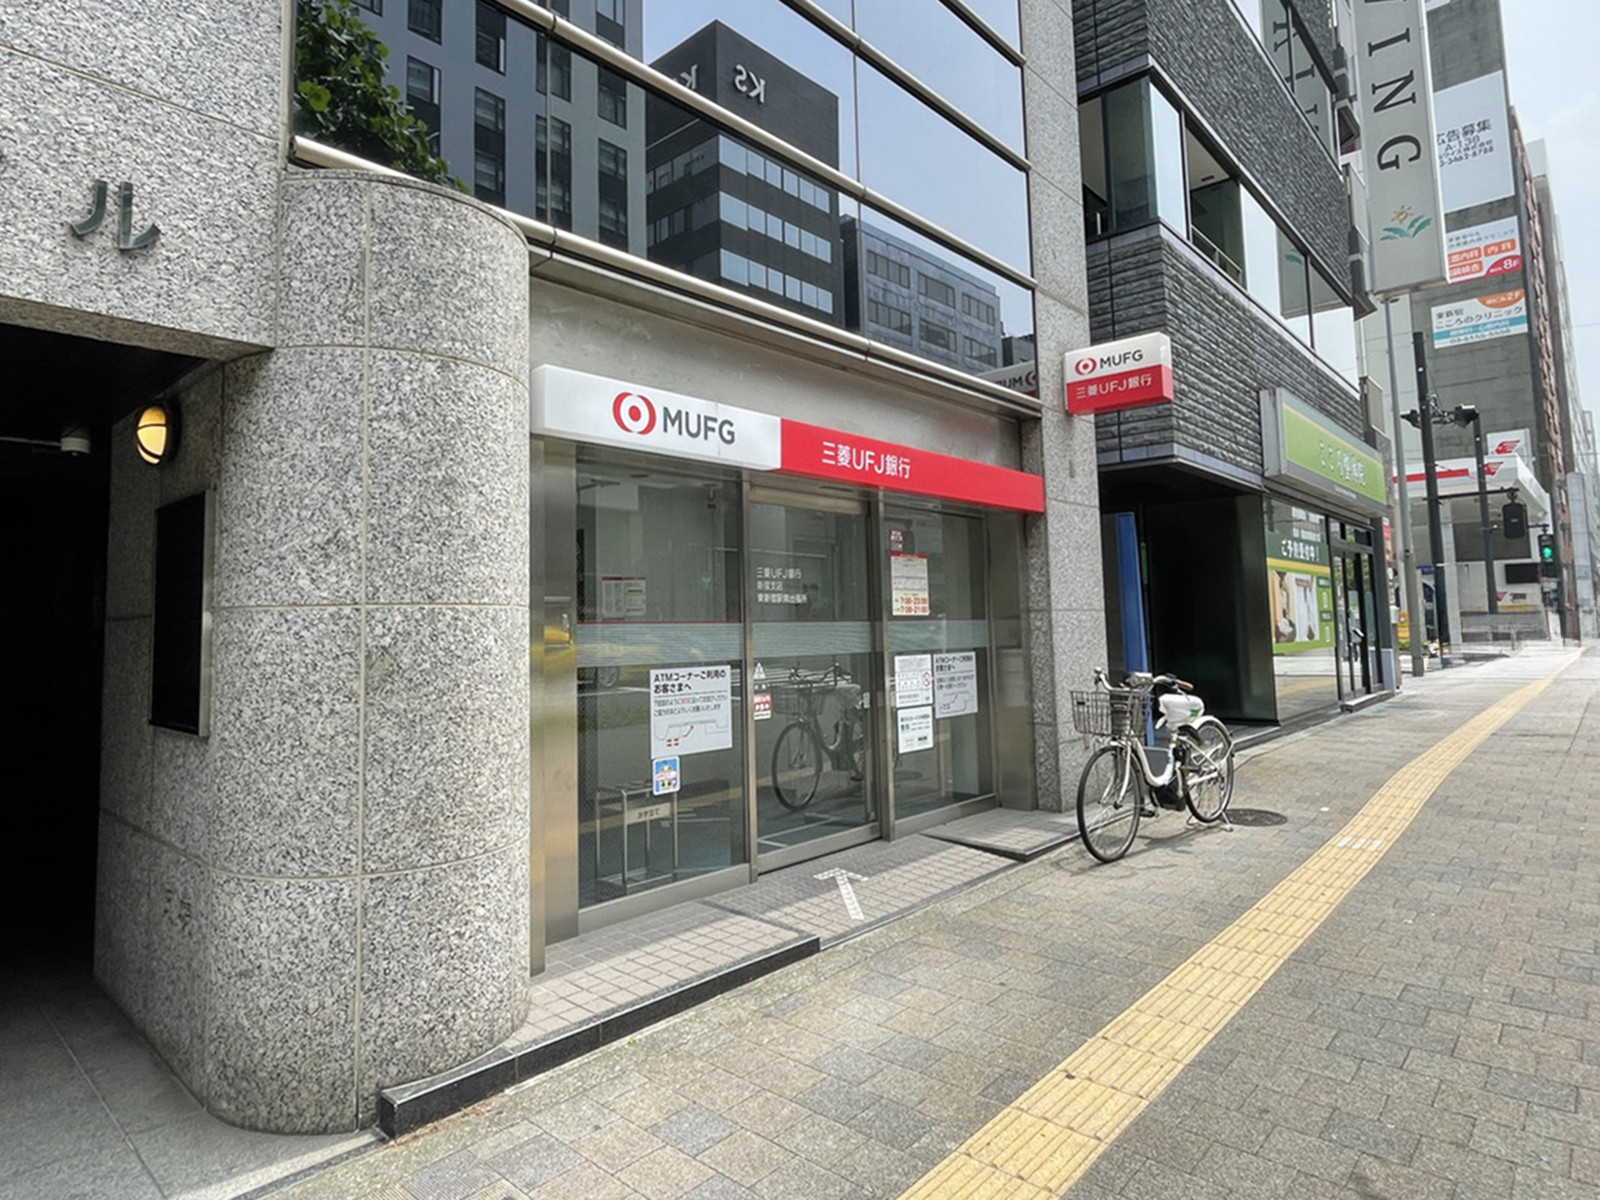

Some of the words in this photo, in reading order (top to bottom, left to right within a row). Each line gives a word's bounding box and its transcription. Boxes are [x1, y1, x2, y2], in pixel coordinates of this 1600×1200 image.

[1364, 0, 1422, 171] ING
[1435, 305, 1523, 330] こころのクリニック
[1100, 349, 1143, 369] MUFG
[1075, 374, 1153, 399] 三菱UFJ銀行
[662, 406, 735, 445] MUFG
[821, 441, 911, 479] 三菱UFJ銀行
[653, 669, 727, 684] ATMコーナーご利用の
[654, 682, 692, 695] お客さまへ
